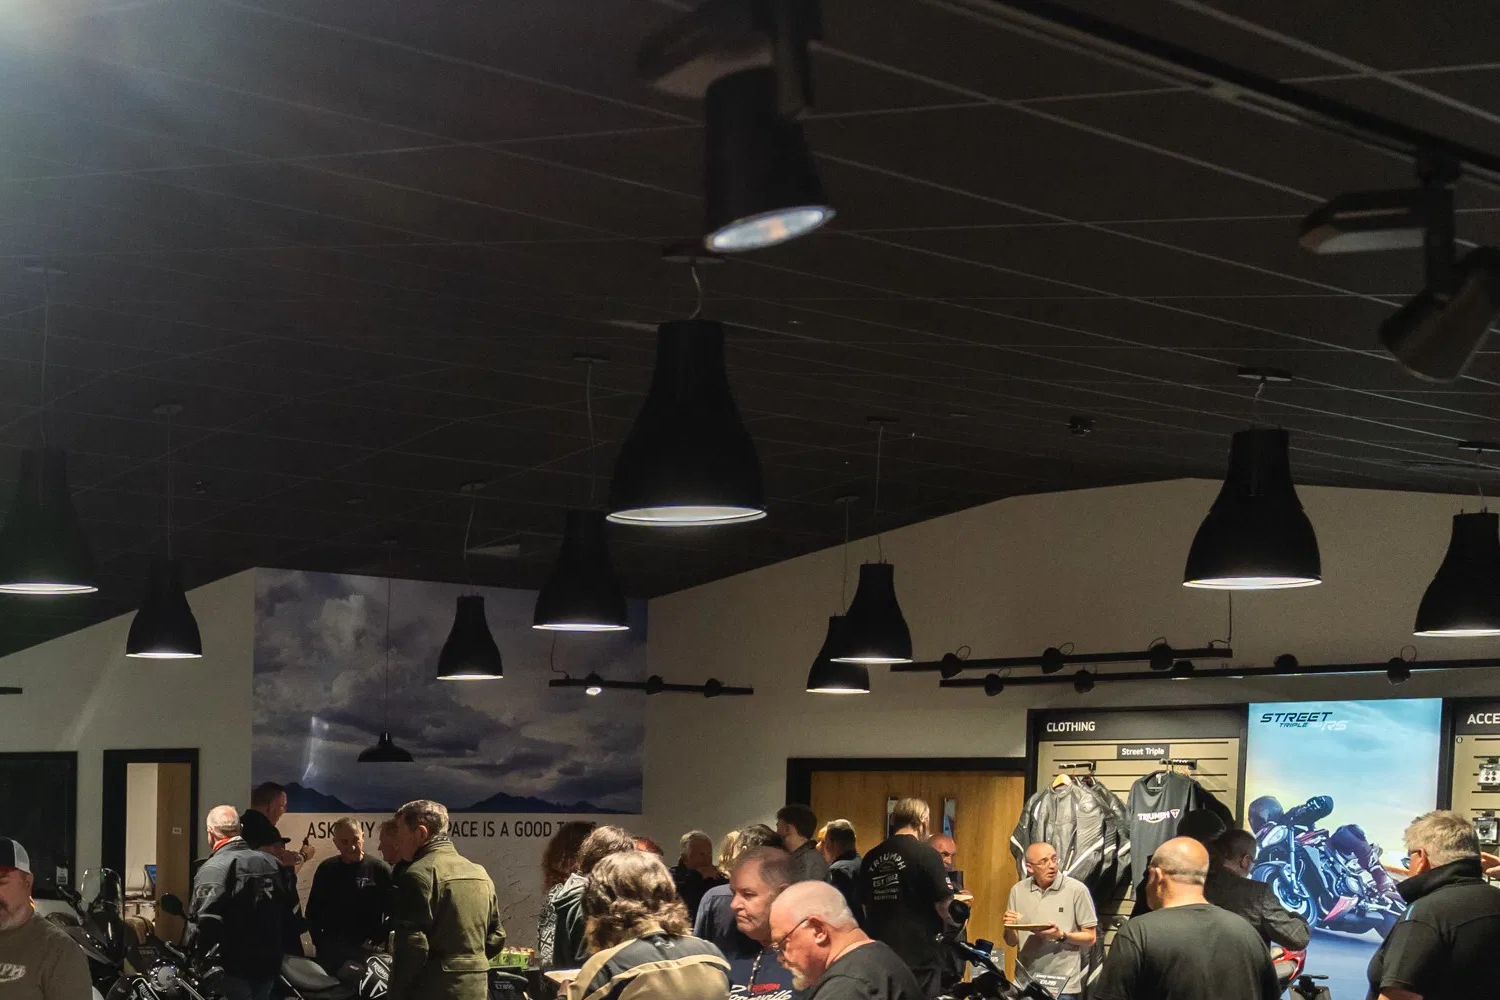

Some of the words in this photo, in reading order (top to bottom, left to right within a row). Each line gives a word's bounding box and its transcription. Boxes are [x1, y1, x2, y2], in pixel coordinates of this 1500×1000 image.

[1260, 712, 1333, 723] STREET
[1046, 721, 1096, 732] CLOTHING
[1121, 747, 1144, 756] Street
[1145, 747, 1165, 756] Triple
[1137, 811, 1170, 823] TRIUMPH
[448, 822, 477, 838] PACE
[483, 822, 495, 837] IS
[501, 822, 510, 837] A
[515, 822, 552, 837] GOOD
[868, 852, 907, 872] TRIUMPH
